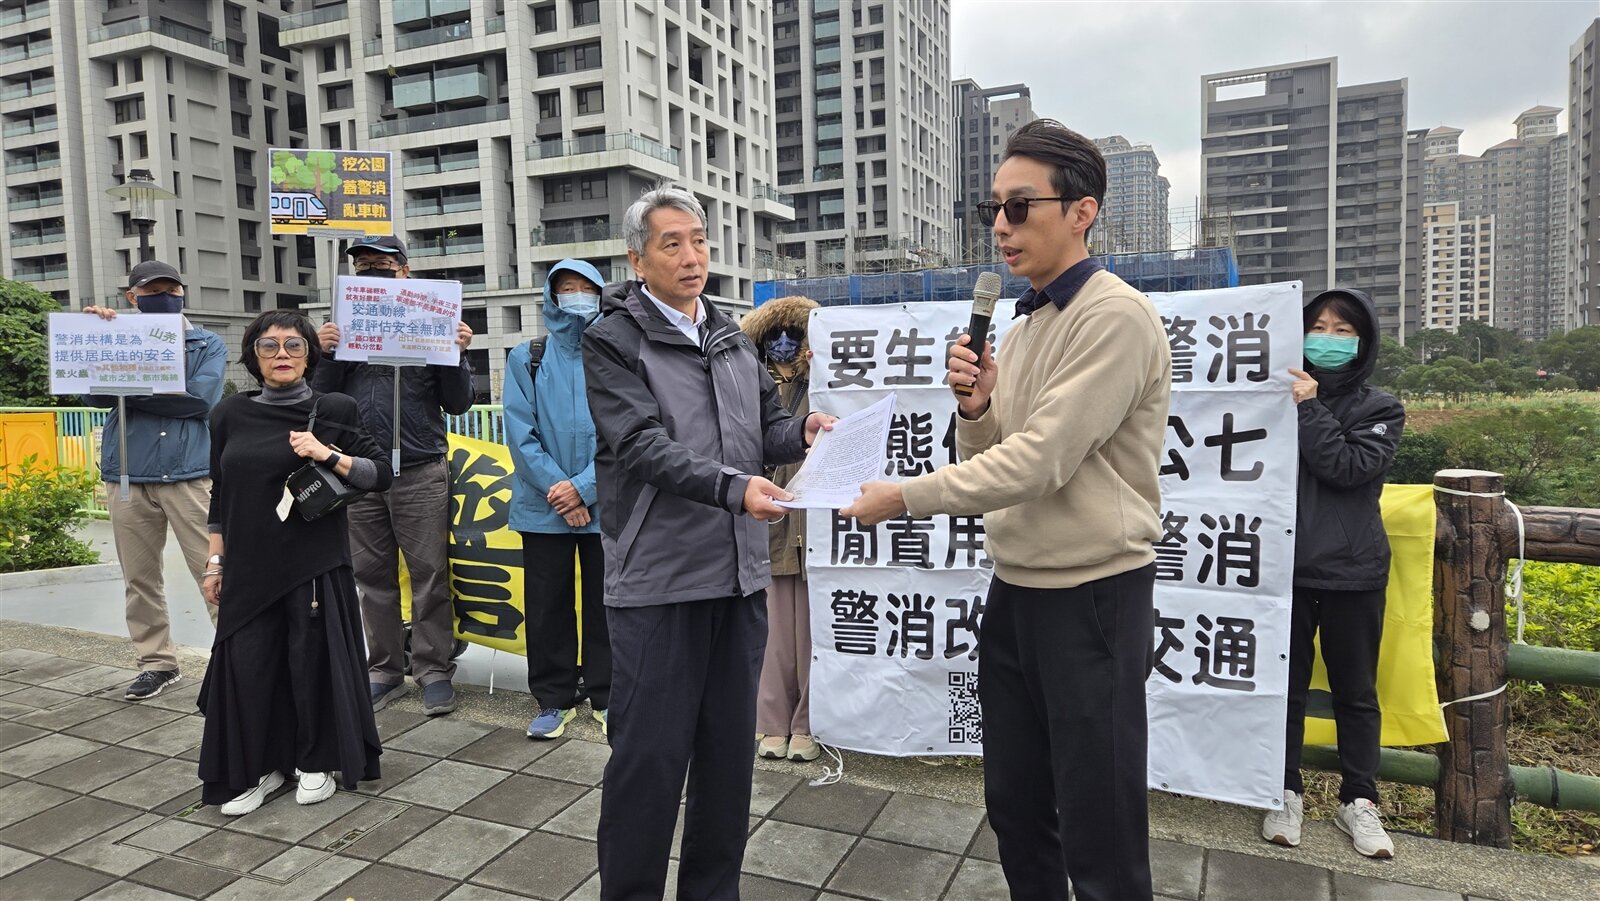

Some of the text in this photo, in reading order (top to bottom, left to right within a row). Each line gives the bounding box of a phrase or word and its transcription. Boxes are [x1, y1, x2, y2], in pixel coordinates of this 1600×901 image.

[343, 156, 386, 172] 挖公園
[343, 180, 386, 195] 蓋警消
[343, 203, 387, 218] 亂車軌
[352, 303, 406, 318] 交通動線
[351, 318, 447, 337] 經評估安全無虞
[55, 333, 143, 346] 警消共構是為
[54, 349, 176, 362] 提供居民住的安全
[56, 369, 89, 379] 螢火蟲
[831, 589, 986, 662] 警消改
